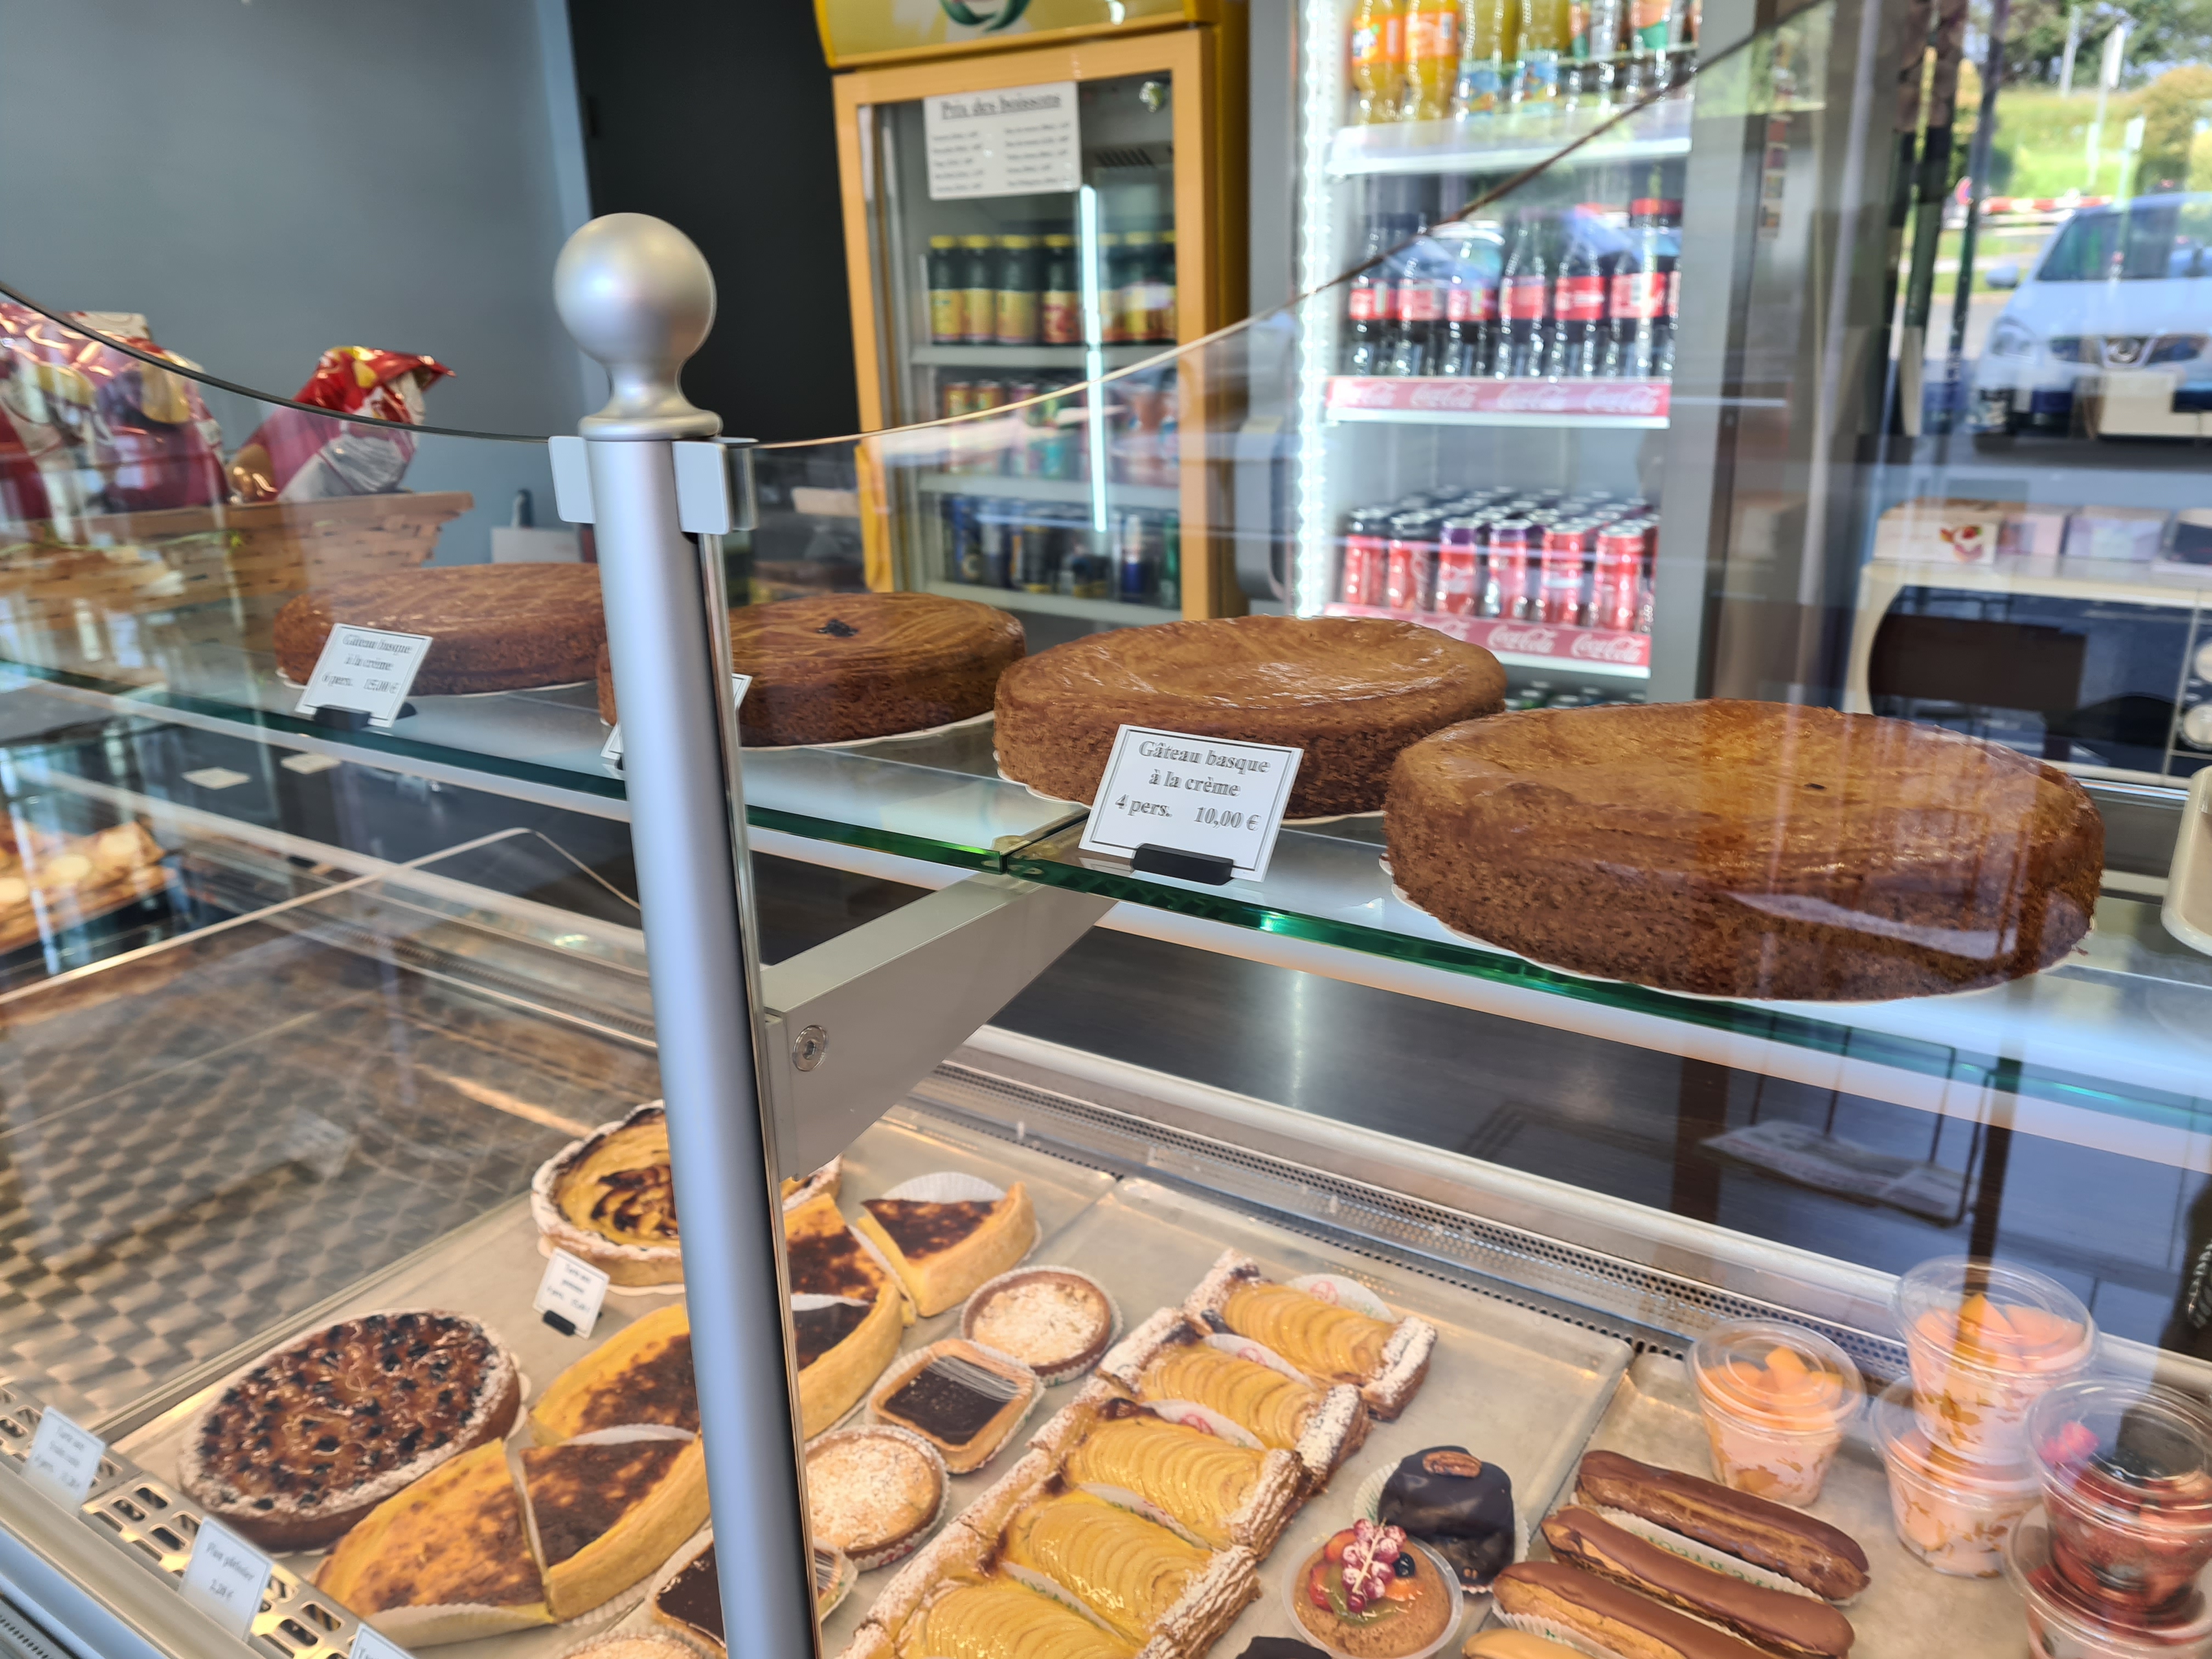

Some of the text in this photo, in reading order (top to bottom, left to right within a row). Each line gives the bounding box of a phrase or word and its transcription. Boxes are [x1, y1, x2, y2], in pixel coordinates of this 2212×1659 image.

[1138, 740, 1271, 775] Gâteau basque
[1148, 769, 1242, 797] à la crème
[1115, 794, 1262, 831] 4 pers. 10,00 €
